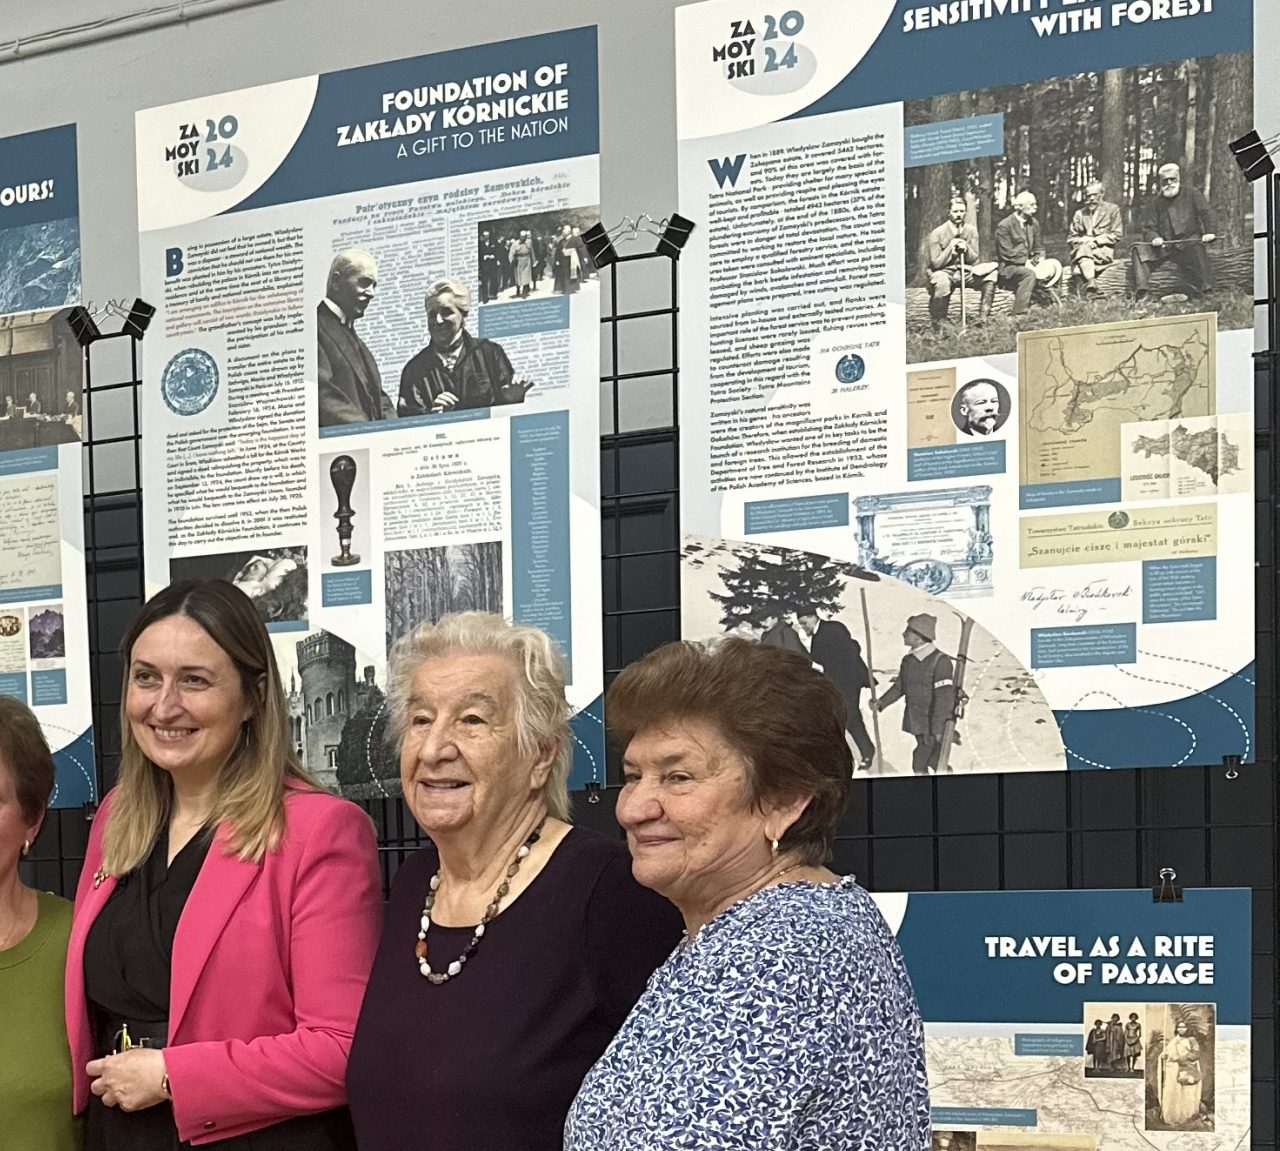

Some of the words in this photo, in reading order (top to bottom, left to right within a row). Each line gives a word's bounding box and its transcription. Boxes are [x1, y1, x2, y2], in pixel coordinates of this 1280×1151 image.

[731, 19, 755, 39] ZA
[763, 10, 805, 41] 20
[1030, 7, 1102, 38] WITH
[713, 38, 756, 62] MOY
[763, 42, 798, 73] 24
[728, 59, 755, 80] SKI
[382, 70, 527, 114] FOUNDATION
[534, 63, 569, 88] OF
[205, 115, 239, 143] 20
[337, 111, 438, 147] ZAKŁADY
[442, 89, 569, 129] KÓRNICKIE
[179, 123, 200, 140] ZA
[396, 144, 408, 158] A
[412, 135, 447, 156] GIFT
[452, 132, 474, 149] TO
[479, 126, 505, 145] THE
[511, 117, 568, 141] NATION
[165, 140, 200, 161] MOY
[206, 144, 233, 172] 24
[177, 159, 199, 178] SKI
[0, 179, 54, 206] OURS!
[728, 482, 746, 490] Polish
[748, 479, 776, 490] Academy
[1123, 538, 1168, 551] majestat
[985, 936, 1083, 958] TRAVEL
[1089, 936, 1120, 958] AS
[1127, 936, 1147, 957] A
[1154, 935, 1214, 957] RITE
[1053, 962, 1092, 985] OF
[1101, 962, 1214, 984] PASSAGE
